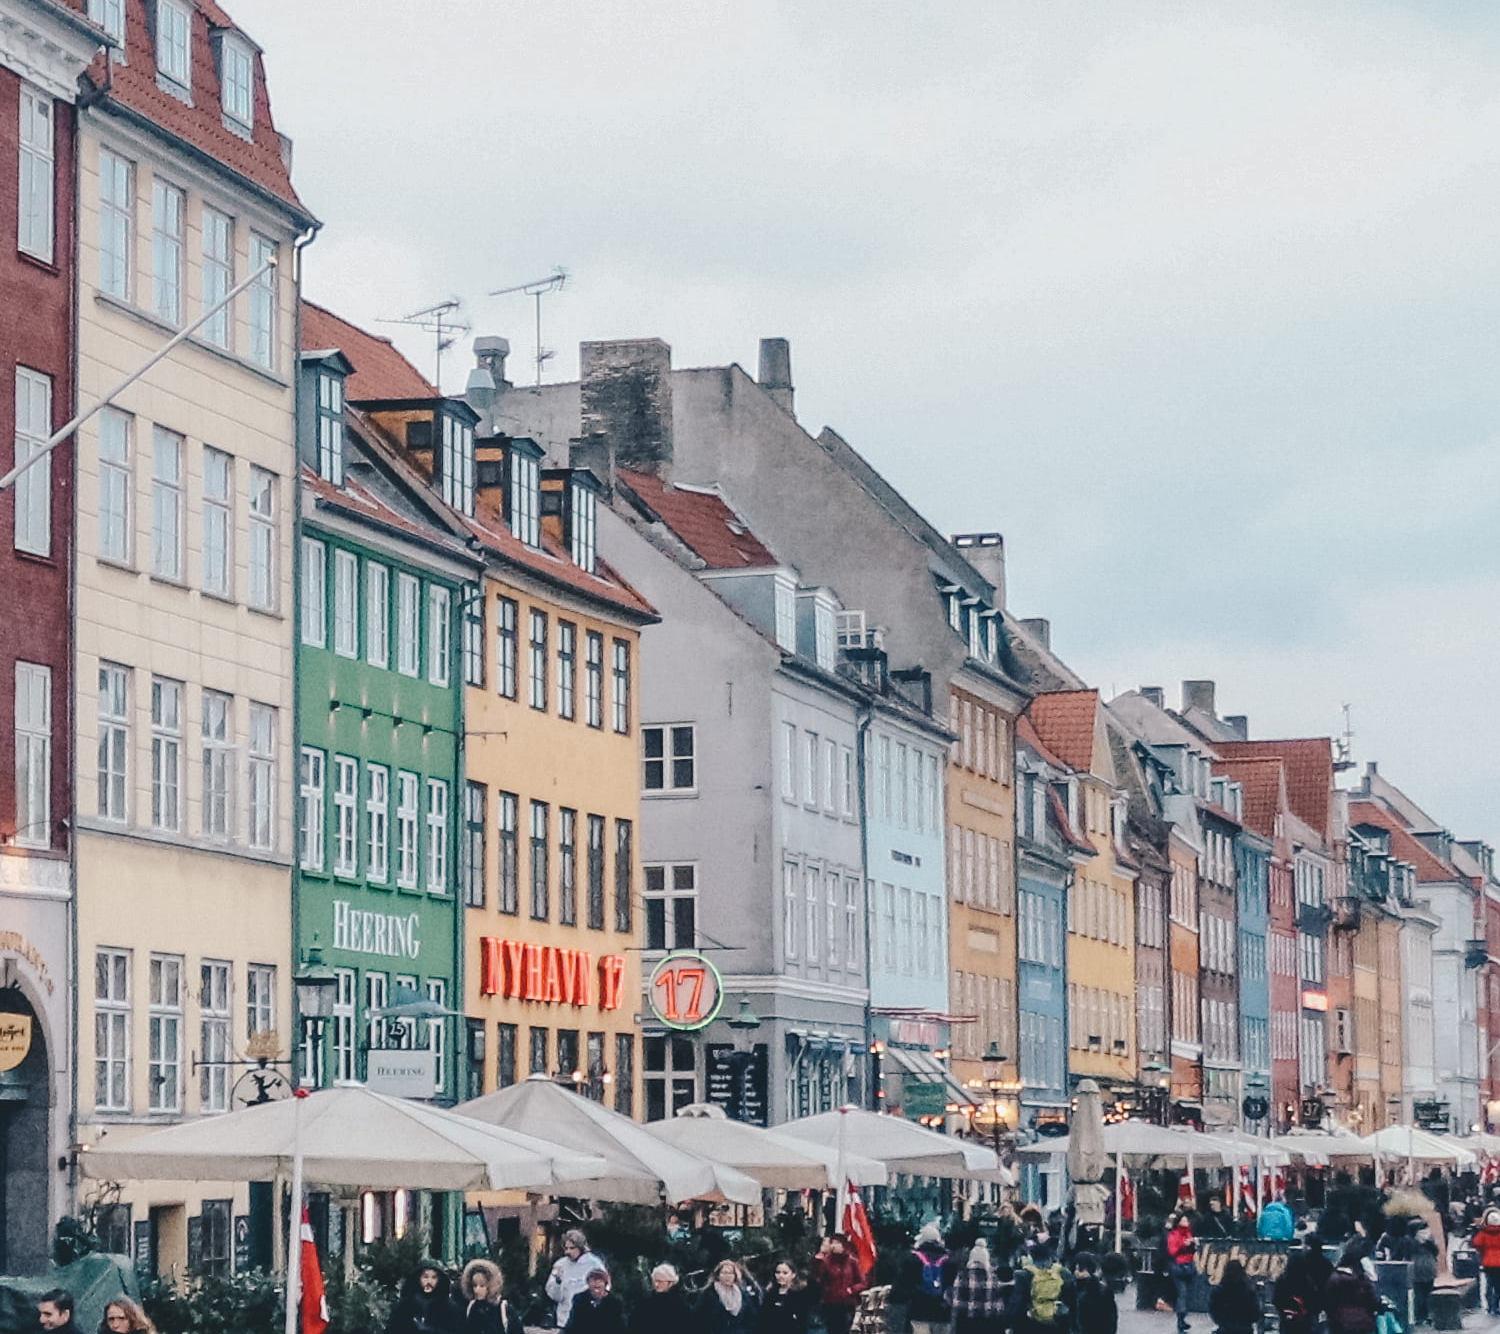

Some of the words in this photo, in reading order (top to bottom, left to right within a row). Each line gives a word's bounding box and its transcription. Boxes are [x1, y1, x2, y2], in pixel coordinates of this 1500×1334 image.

[332, 899, 421, 959] HEERING
[481, 936, 592, 1007] NYHAVN
[598, 954, 625, 1010] 17
[656, 969, 705, 1020] 17
